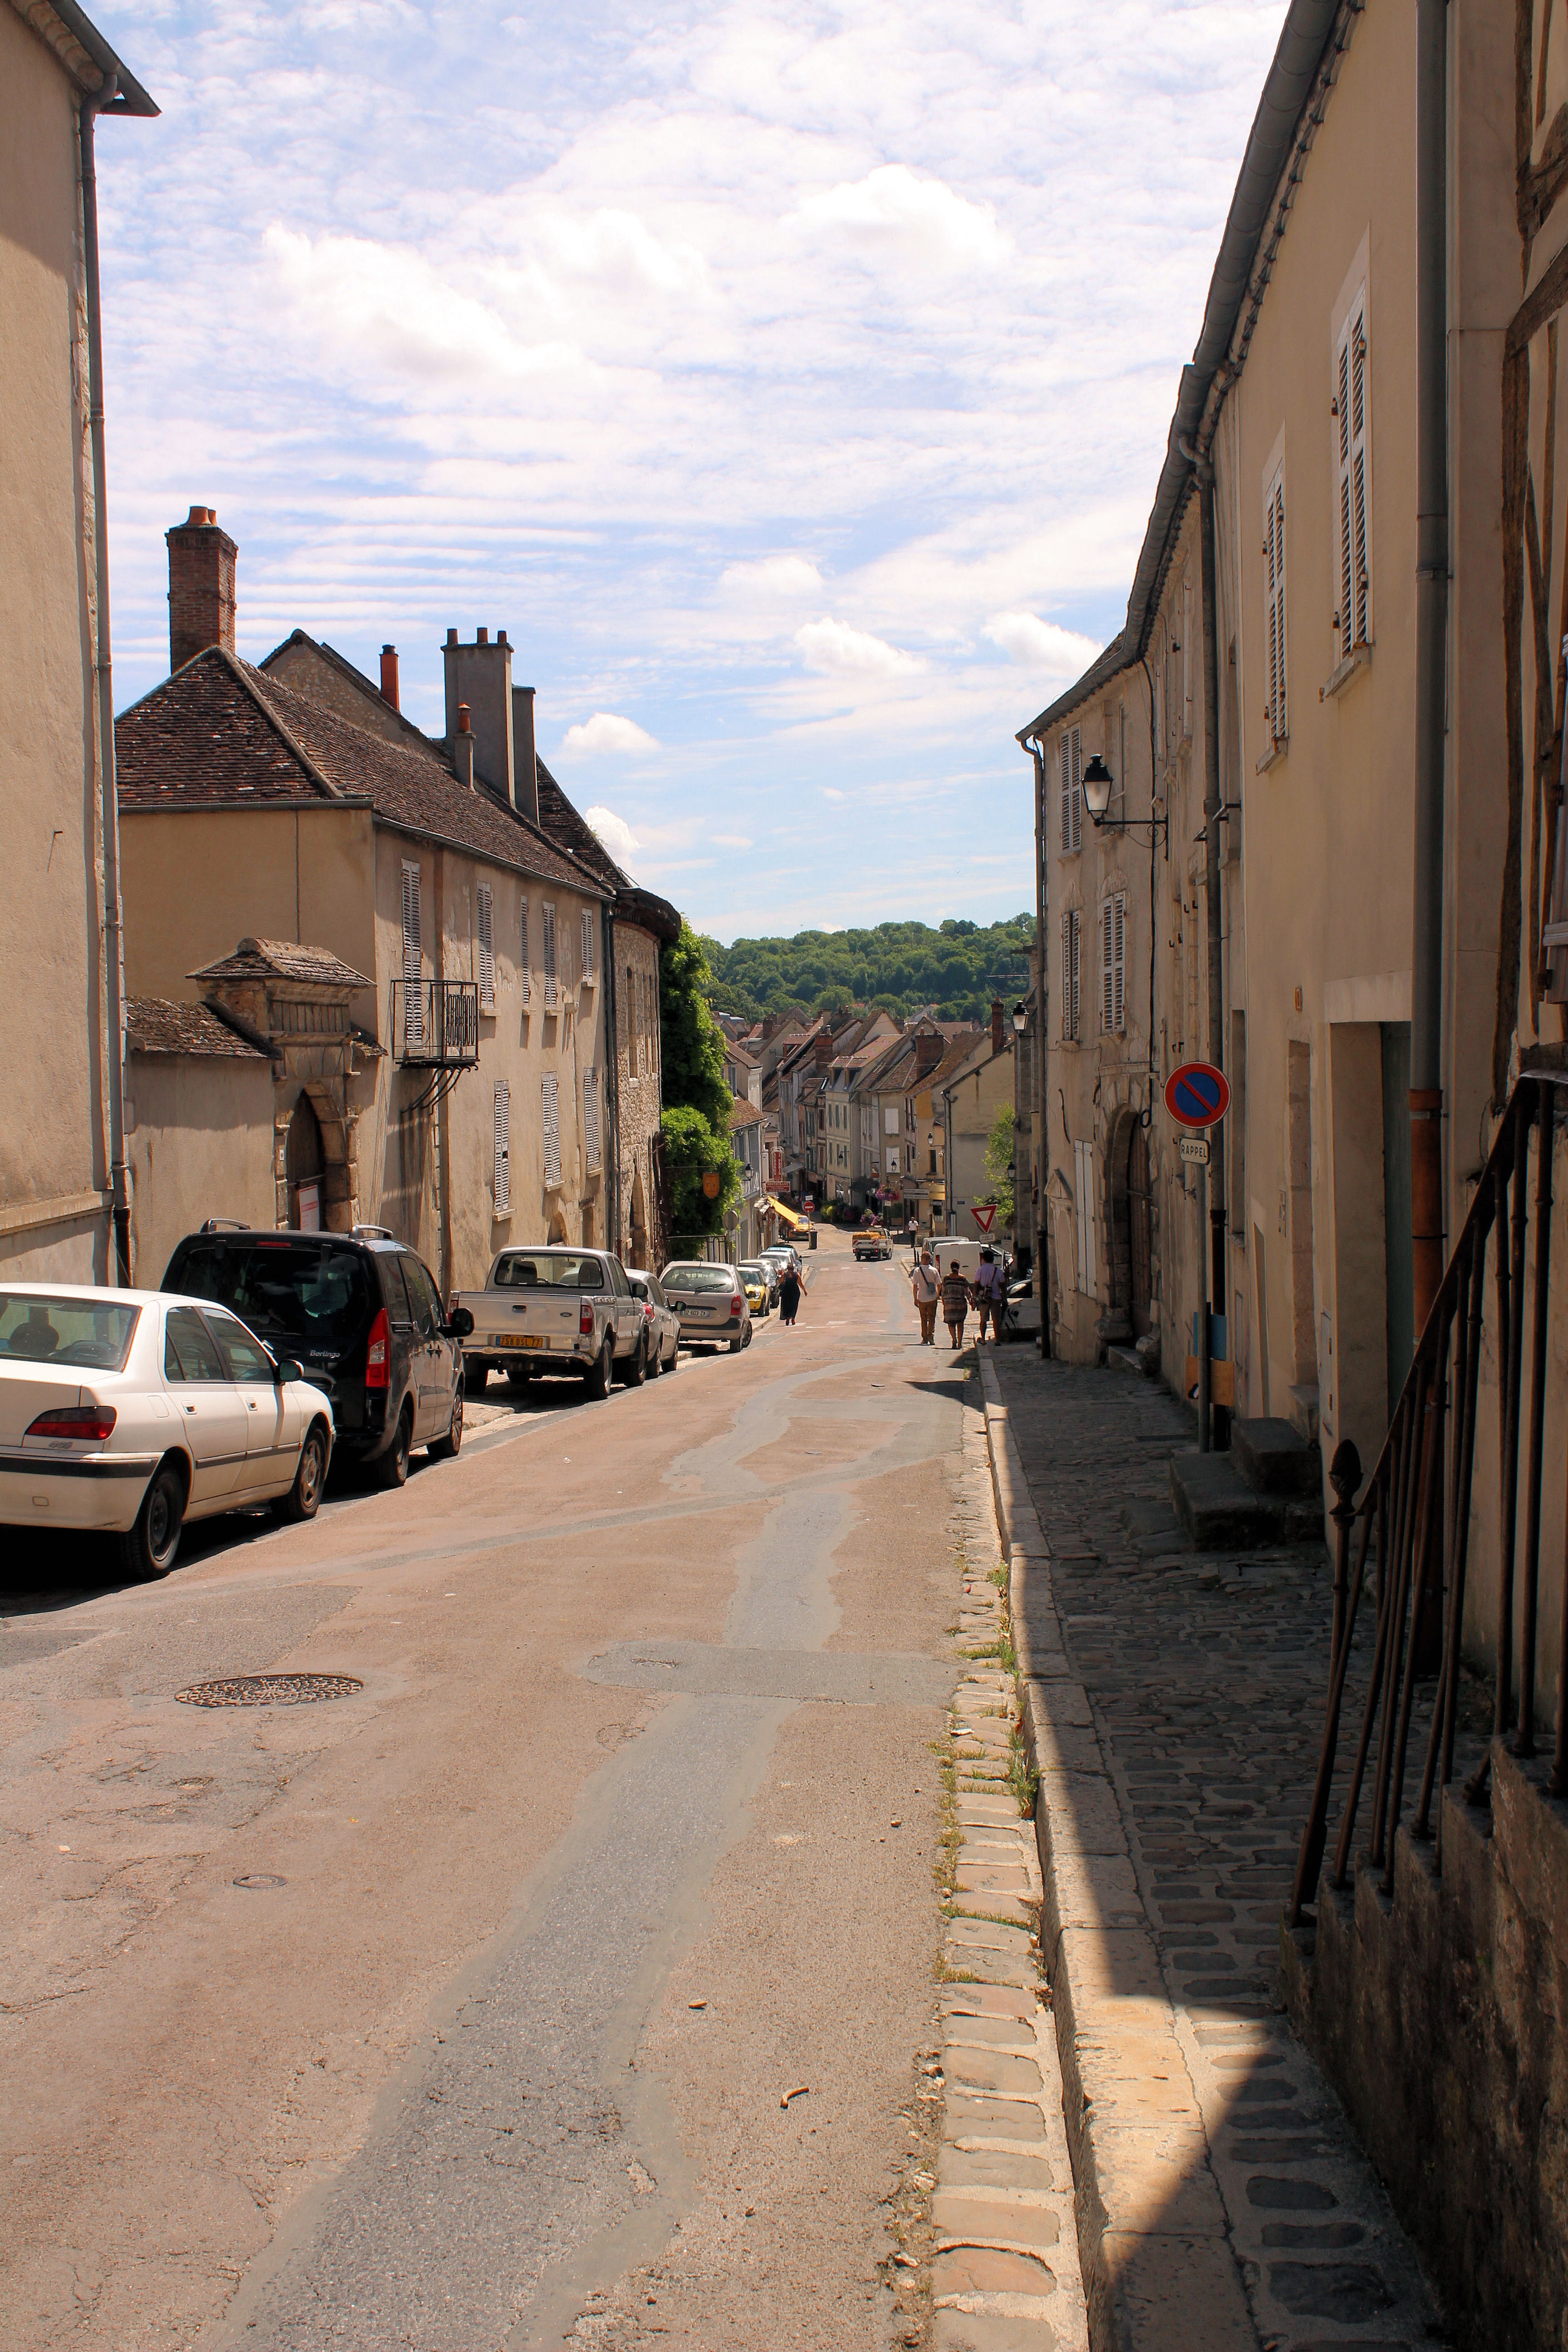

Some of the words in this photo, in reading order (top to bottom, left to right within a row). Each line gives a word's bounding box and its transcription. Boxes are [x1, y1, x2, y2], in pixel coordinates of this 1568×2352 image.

[1181, 1144, 1207, 1158] RAPPEL
[500, 1337, 514, 1345] 758
[516, 1338, 529, 1346] DSL
[309, 1350, 341, 1358] Berlingo
